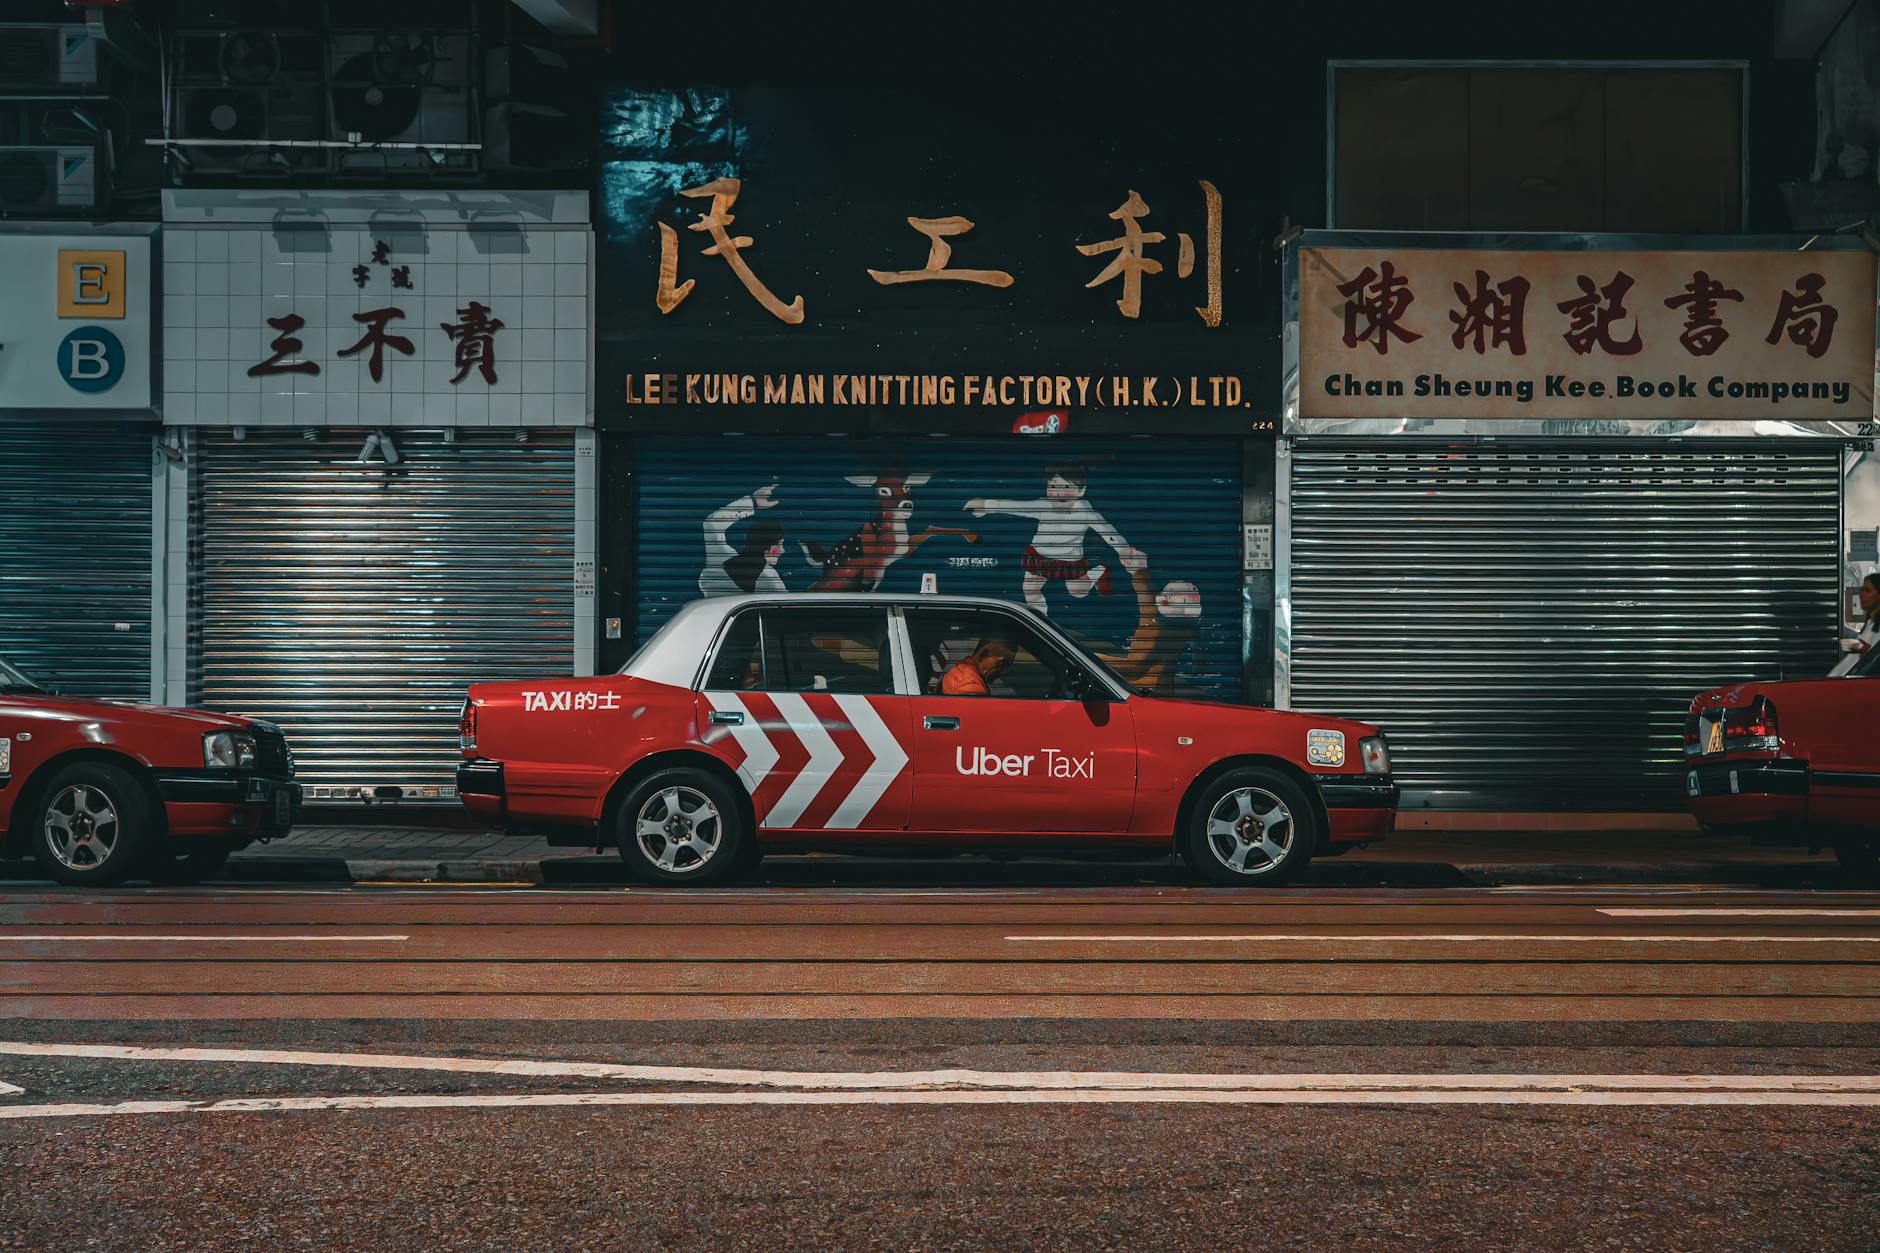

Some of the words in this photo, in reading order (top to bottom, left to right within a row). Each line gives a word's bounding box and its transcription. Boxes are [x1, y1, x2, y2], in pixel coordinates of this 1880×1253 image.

[72, 264, 110, 304] E
[1336, 260, 1839, 359] 陳湘記書局
[70, 339, 111, 380] B
[247, 301, 506, 386] 三不賣
[626, 374, 679, 404] LEE
[686, 374, 757, 404] KUNG
[763, 374, 825, 404] MAN
[832, 374, 956, 405] KNITTING
[963, 375, 1091, 406] FACTORY
[1095, 376, 1182, 407] (H.K.)
[1190, 376, 1251, 408] LTD.
[1324, 374, 1404, 398] Chan
[1414, 374, 1534, 403] Sheung
[1616, 375, 1697, 399] Book
[1707, 375, 1850, 404] Company
[522, 690, 572, 713] TAXI
[574, 691, 622, 712] 的士
[955, 745, 1035, 778] Uber
[1040, 748, 1095, 779] Taxi
